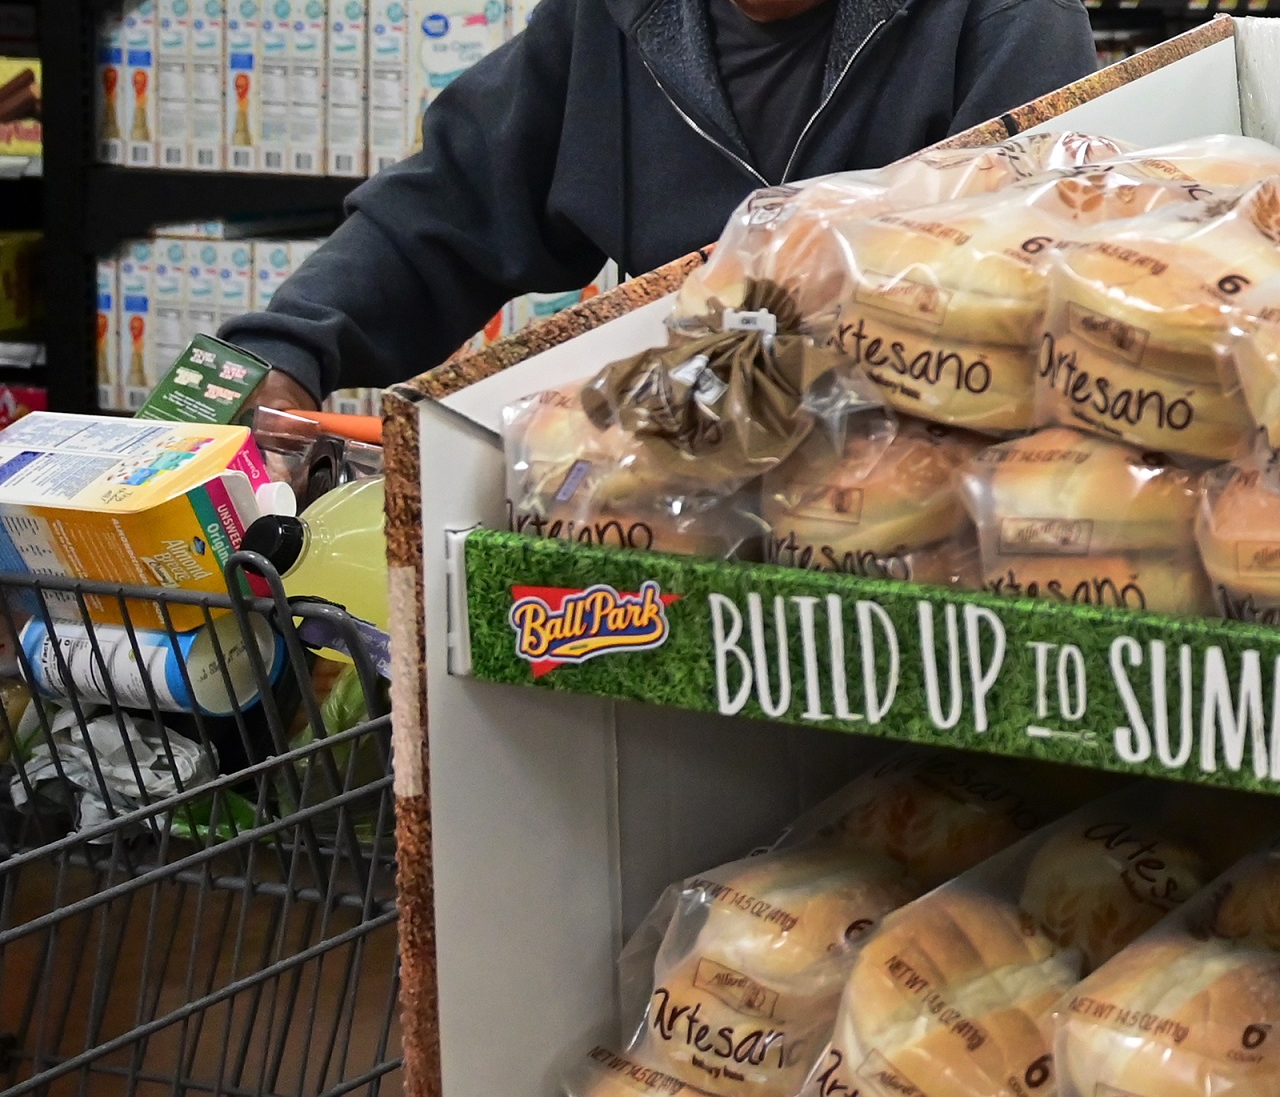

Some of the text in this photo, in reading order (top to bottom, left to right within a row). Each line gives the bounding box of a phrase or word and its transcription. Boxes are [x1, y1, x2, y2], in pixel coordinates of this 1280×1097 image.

[1021, 236, 1054, 254] 6
[1217, 274, 1250, 295] 6
[161, 538, 212, 581] Almond
[514, 585, 665, 656] Ball Park
[708, 591, 900, 724] BUILD
[917, 600, 1008, 734] UP
[1026, 640, 1087, 722] TO
[1241, 1023, 1272, 1049] 6
[1024, 1053, 1054, 1088] 6
